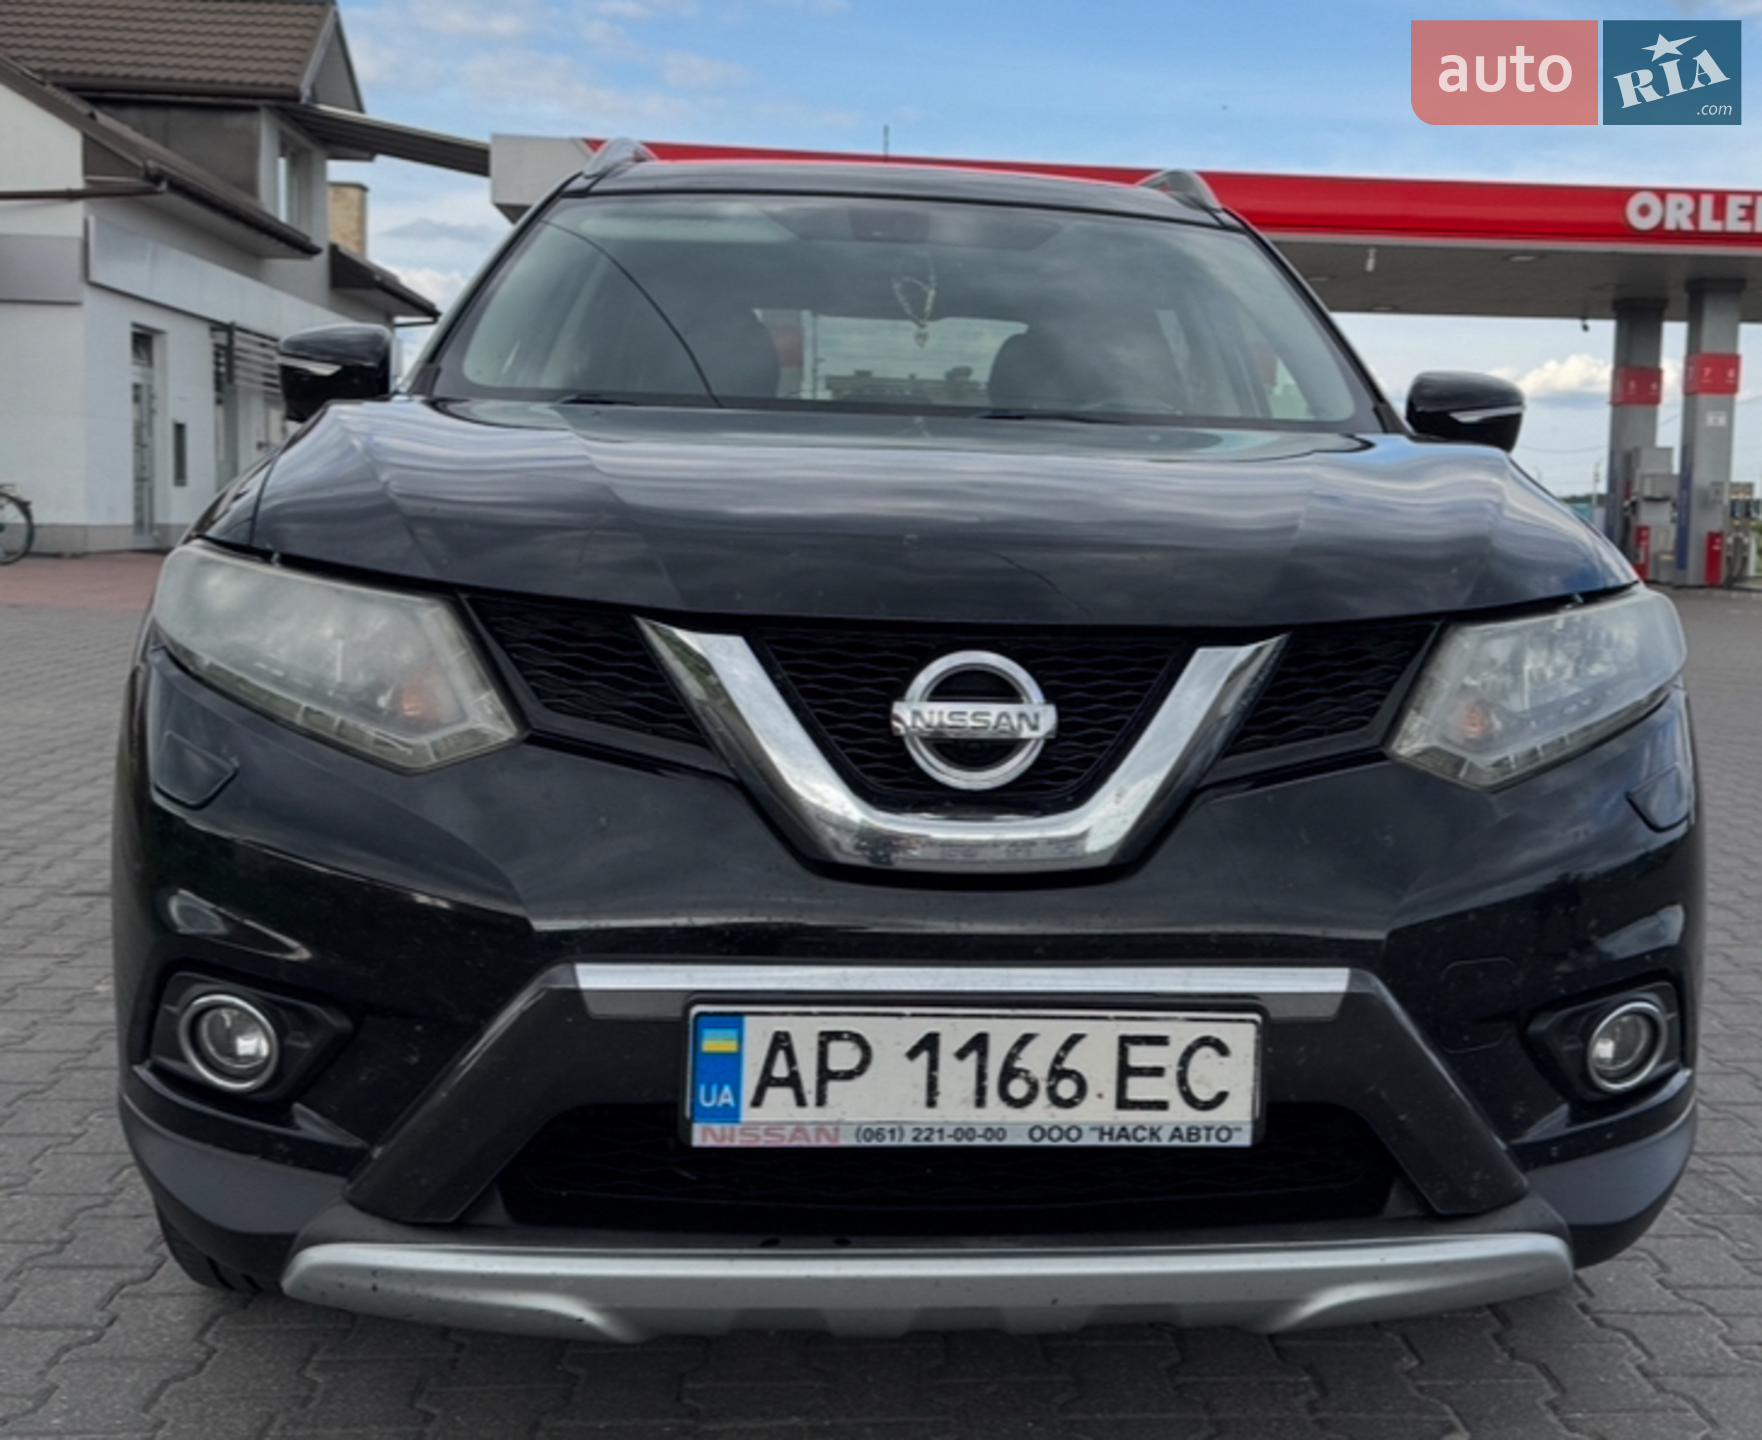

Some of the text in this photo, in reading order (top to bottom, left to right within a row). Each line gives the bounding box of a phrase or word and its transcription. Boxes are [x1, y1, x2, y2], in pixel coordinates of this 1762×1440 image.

[1626, 190, 1762, 233] ORLE
[911, 710, 1040, 731] NISSAN
[750, 1030, 1231, 1111] AP 1166 EC
[700, 1083, 736, 1107] UA
[701, 1125, 1007, 1144] NISSAN (061) 221-00-00
[1028, 1125, 1083, 1143] ООО
